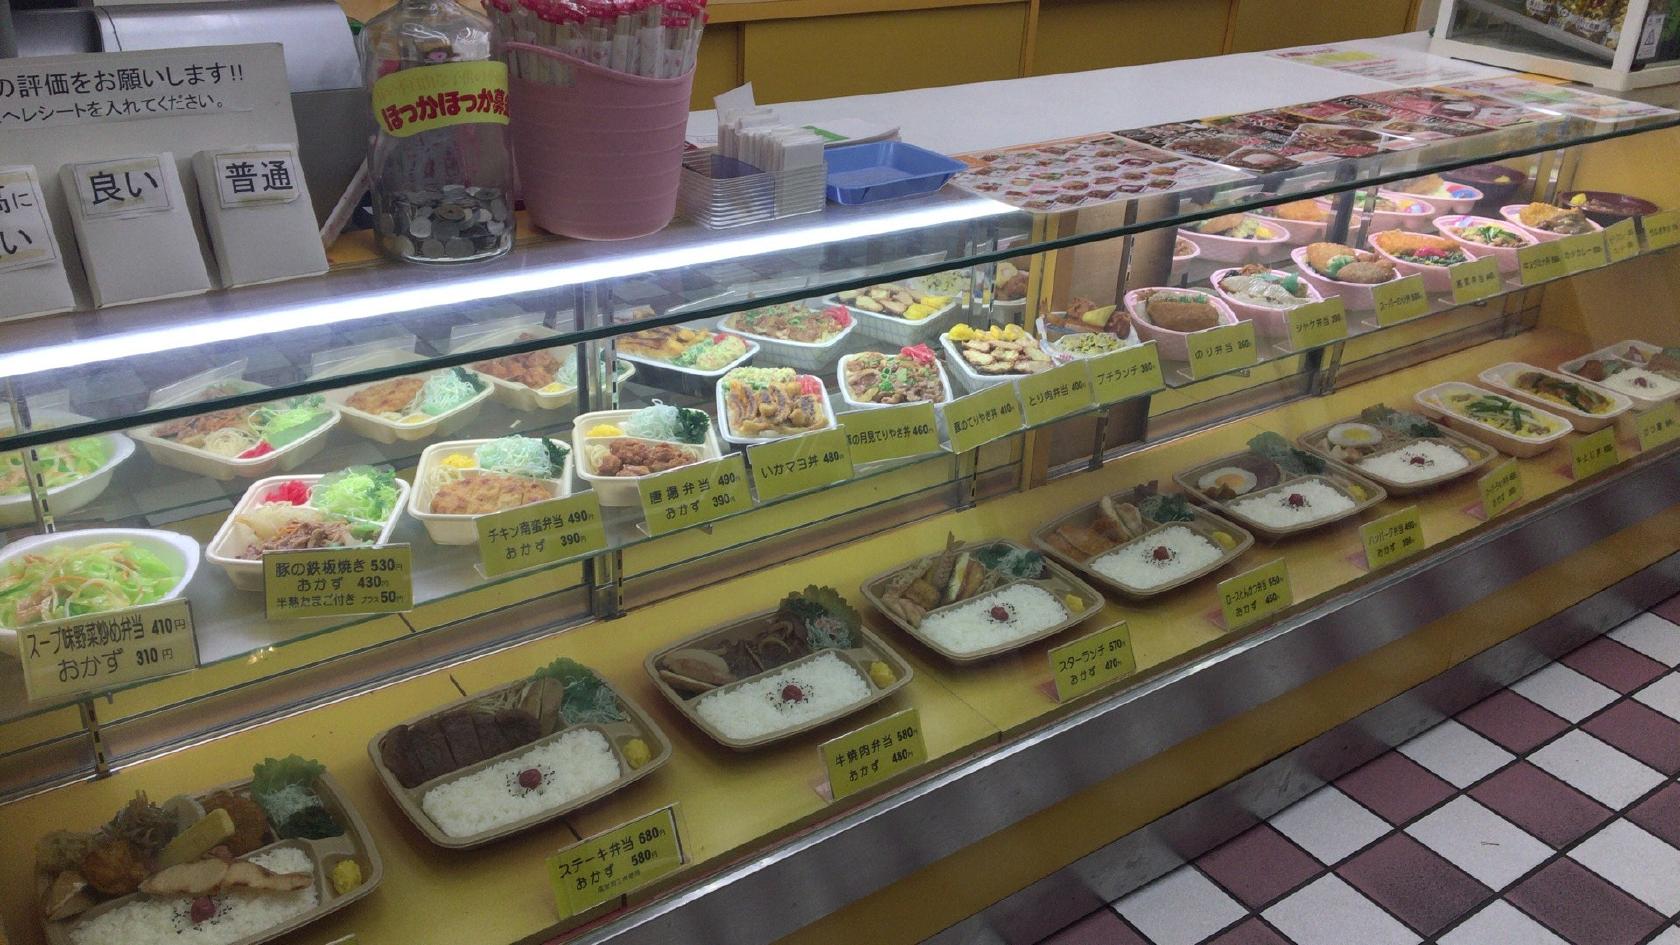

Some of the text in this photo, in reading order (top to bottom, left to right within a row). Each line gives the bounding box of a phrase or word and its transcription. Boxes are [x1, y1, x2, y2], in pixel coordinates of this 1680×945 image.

[90, 170, 158, 205] 良い
[225, 159, 293, 194] 普通
[1194, 343, 1233, 360] のり弁当
[1096, 365, 1137, 385] プチランチ
[1028, 387, 1069, 407] とり肉弁当
[761, 455, 818, 479] いかマヨ丼
[665, 499, 700, 520] おかず
[488, 514, 564, 543] チキン南蛮弁当
[505, 538, 545, 560] おかず
[275, 559, 366, 577] 豚の鉄板焼き
[297, 576, 343, 592] おかず
[276, 593, 354, 609] 半熟たまご付き
[1235, 599, 1257, 617] おかず
[27, 614, 187, 659] スープ味野菜炒め弁当 410円
[57, 647, 173, 683] おかず 310円
[1059, 644, 1105, 673] スターランチ
[1070, 665, 1096, 686] おかず
[835, 733, 893, 767] 牛焼肉弁当
[849, 759, 880, 782] おかず
[558, 836, 634, 879] ステーキ弁当
[576, 863, 614, 891] おかず
